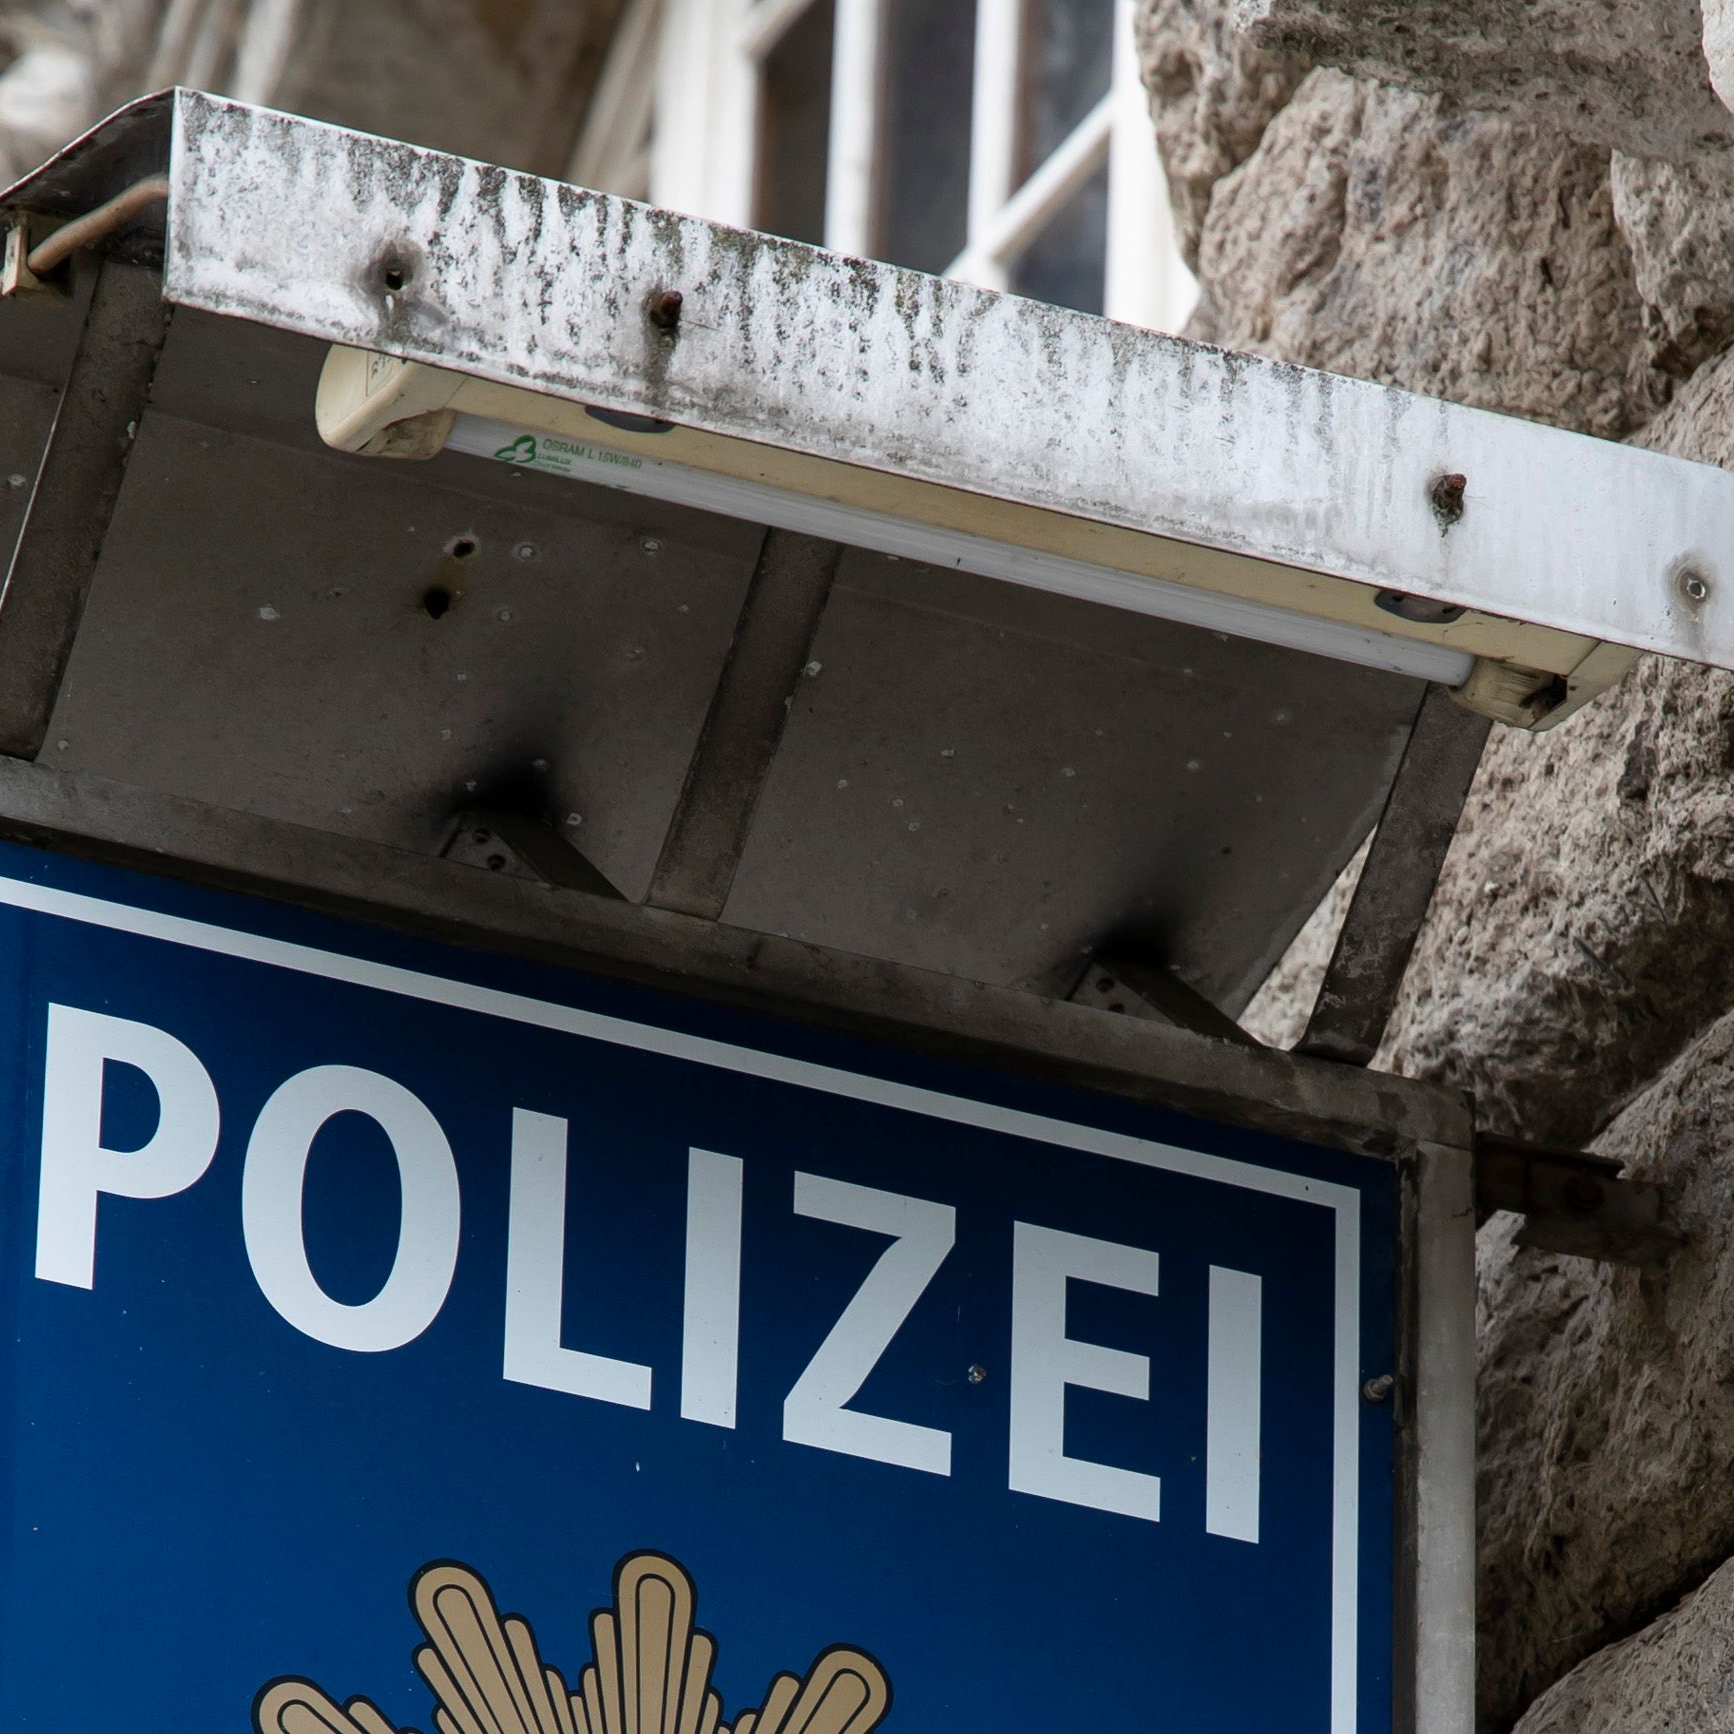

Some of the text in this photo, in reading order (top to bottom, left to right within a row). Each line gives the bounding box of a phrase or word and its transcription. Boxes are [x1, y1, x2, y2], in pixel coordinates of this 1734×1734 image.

[542, 438, 585, 457] OSRAM
[587, 447, 594, 460] L
[34, 1002, 1261, 1545] POLIZEI
